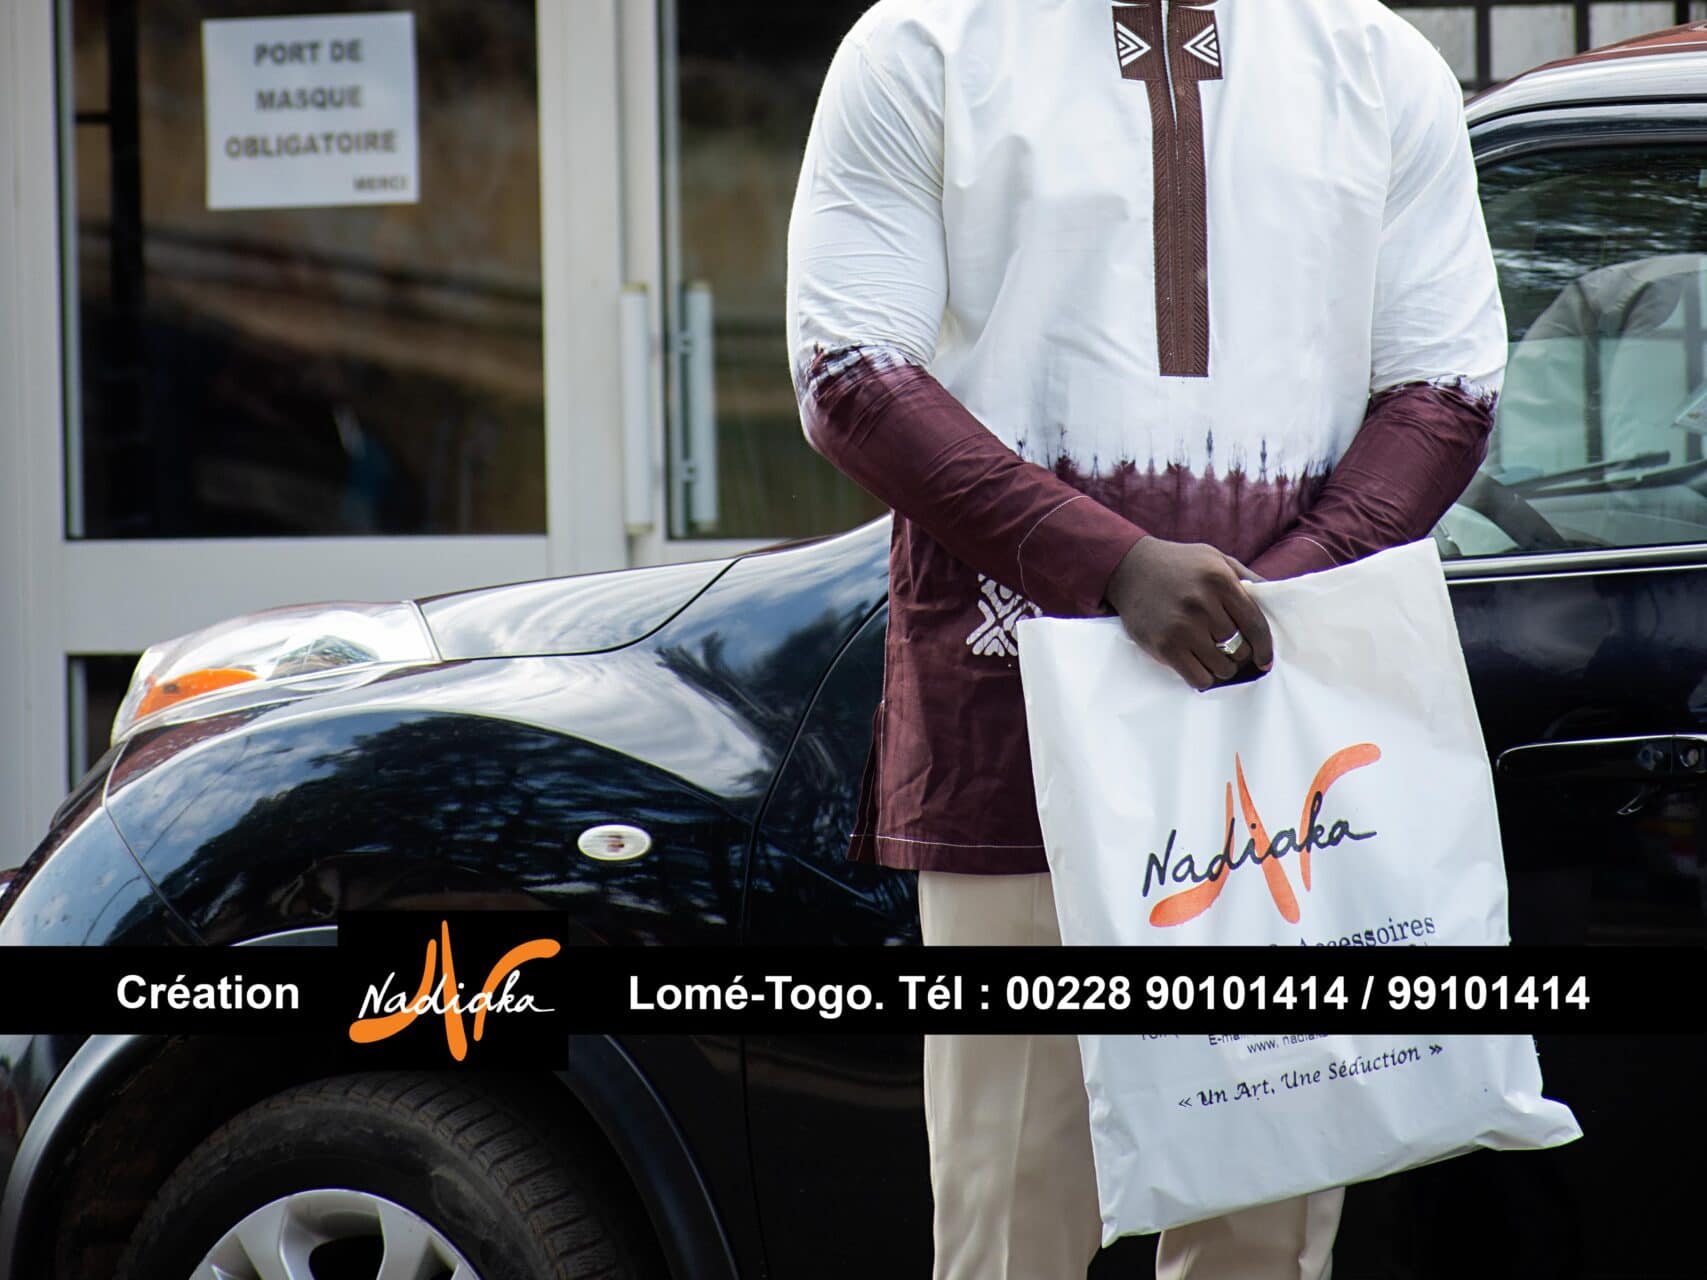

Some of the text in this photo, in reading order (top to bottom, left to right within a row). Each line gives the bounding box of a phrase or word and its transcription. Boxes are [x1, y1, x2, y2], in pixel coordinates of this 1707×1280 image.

[255, 38, 363, 66] PORT DE
[256, 86, 363, 111] MASQUE
[225, 130, 397, 159] OBLIGATOIRE
[354, 176, 407, 191] MERCI
[1142, 791, 1377, 897] Nadiaka
[1197, 1086, 1228, 1107] Un
[1234, 1078, 1276, 1101] Art,
[1280, 1070, 1321, 1090] Une
[1328, 1045, 1421, 1081] Séduction
